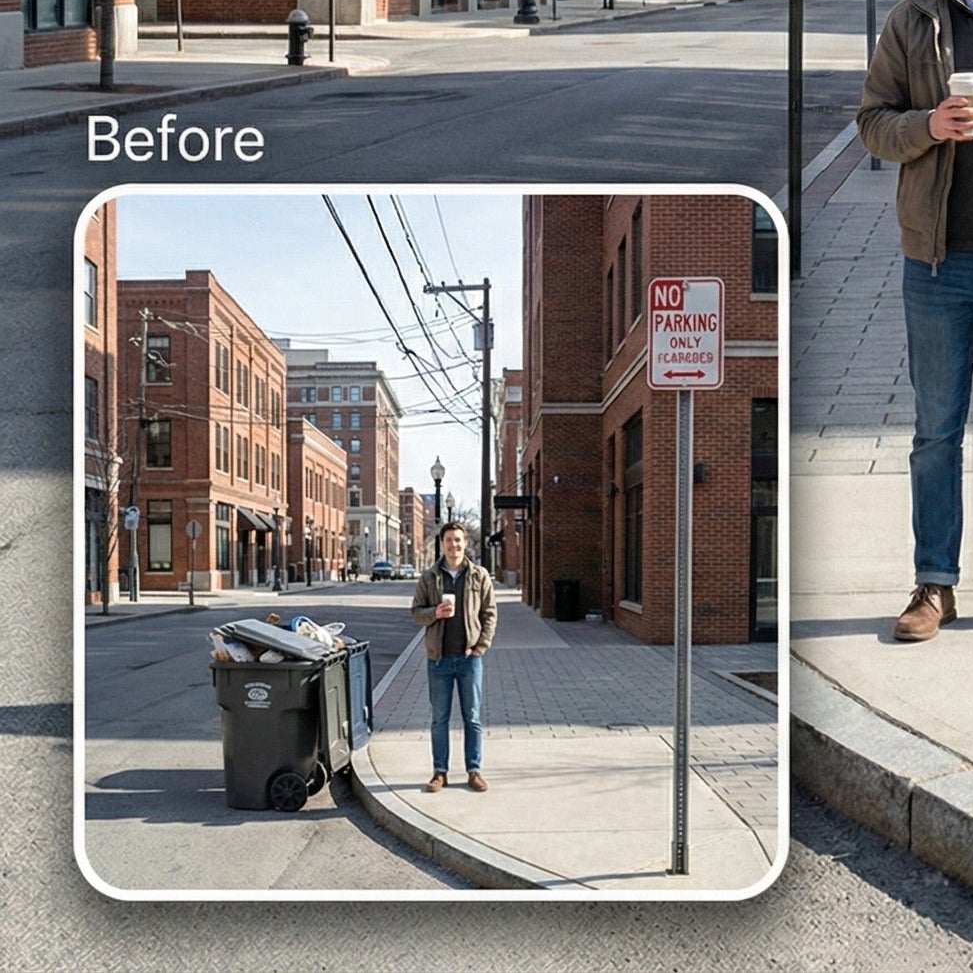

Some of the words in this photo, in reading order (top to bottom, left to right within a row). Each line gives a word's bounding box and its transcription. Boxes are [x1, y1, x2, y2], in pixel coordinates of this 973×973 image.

[654, 285, 681, 307] NO
[655, 313, 717, 332] PARKING
[669, 336, 702, 348] ONLY
